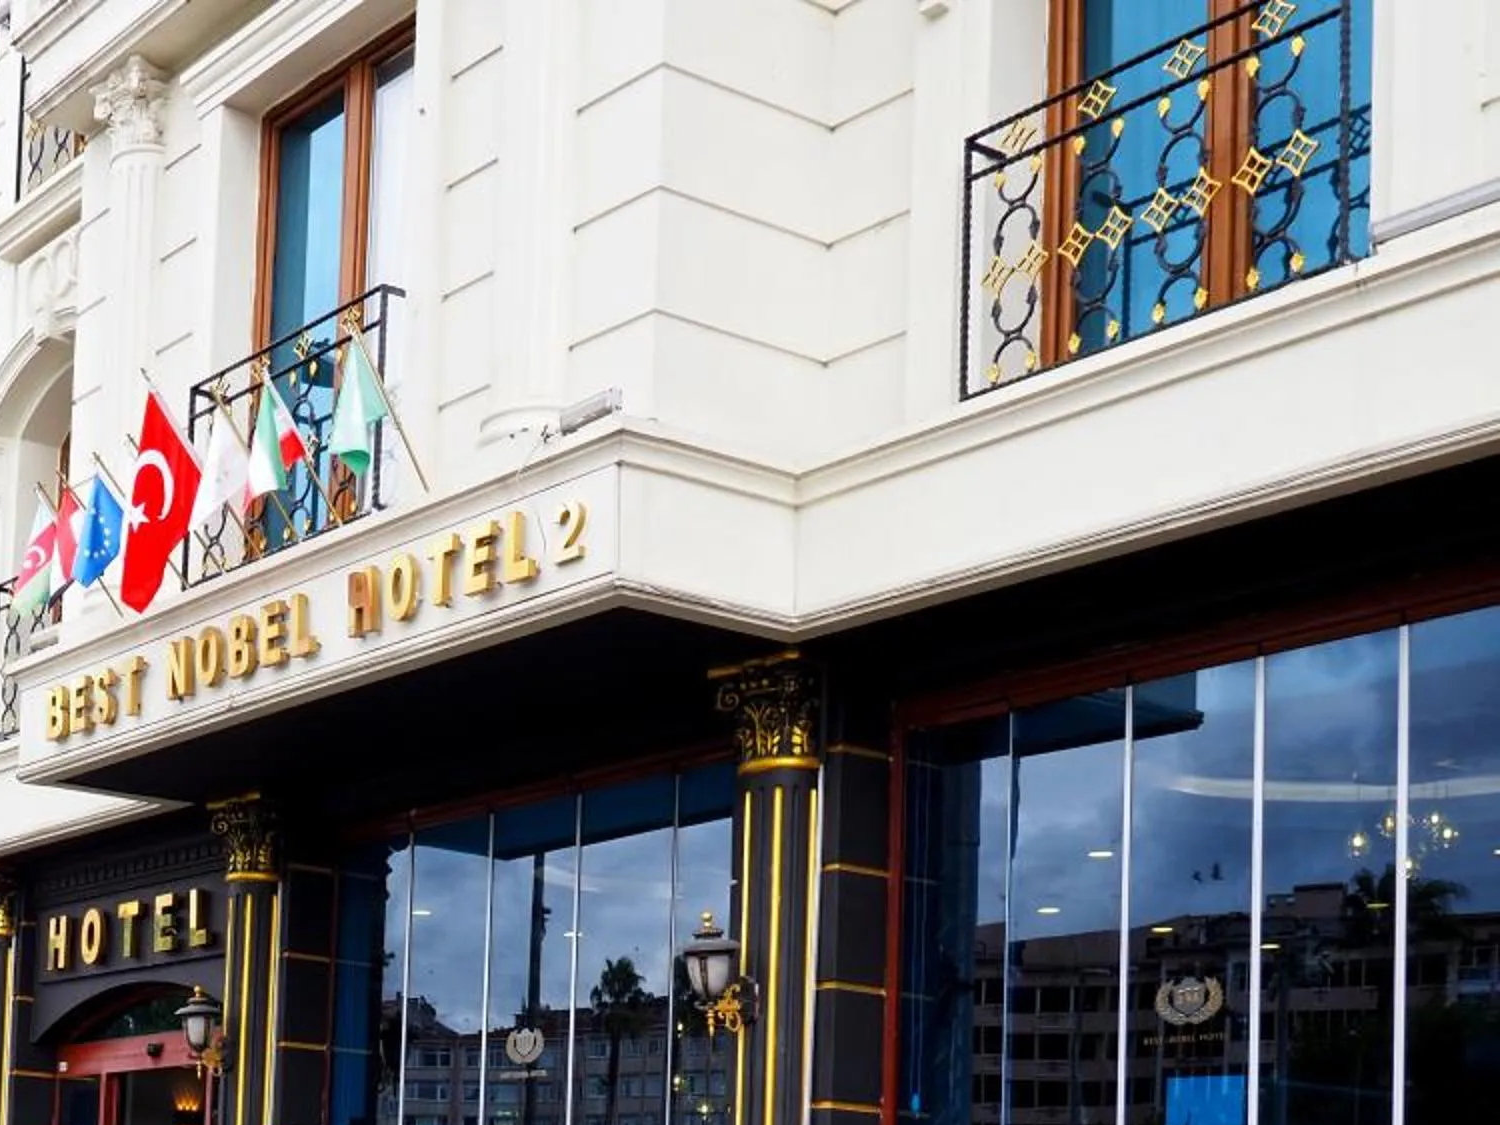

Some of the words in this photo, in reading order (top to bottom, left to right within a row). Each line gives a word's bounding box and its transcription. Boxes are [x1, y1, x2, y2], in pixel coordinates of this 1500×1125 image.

[44, 655, 149, 742] BEST
[166, 592, 322, 701] NOBEL
[347, 509, 538, 639] HOTEL
[553, 500, 588, 565] 2
[46, 888, 213, 971] HOTEL
